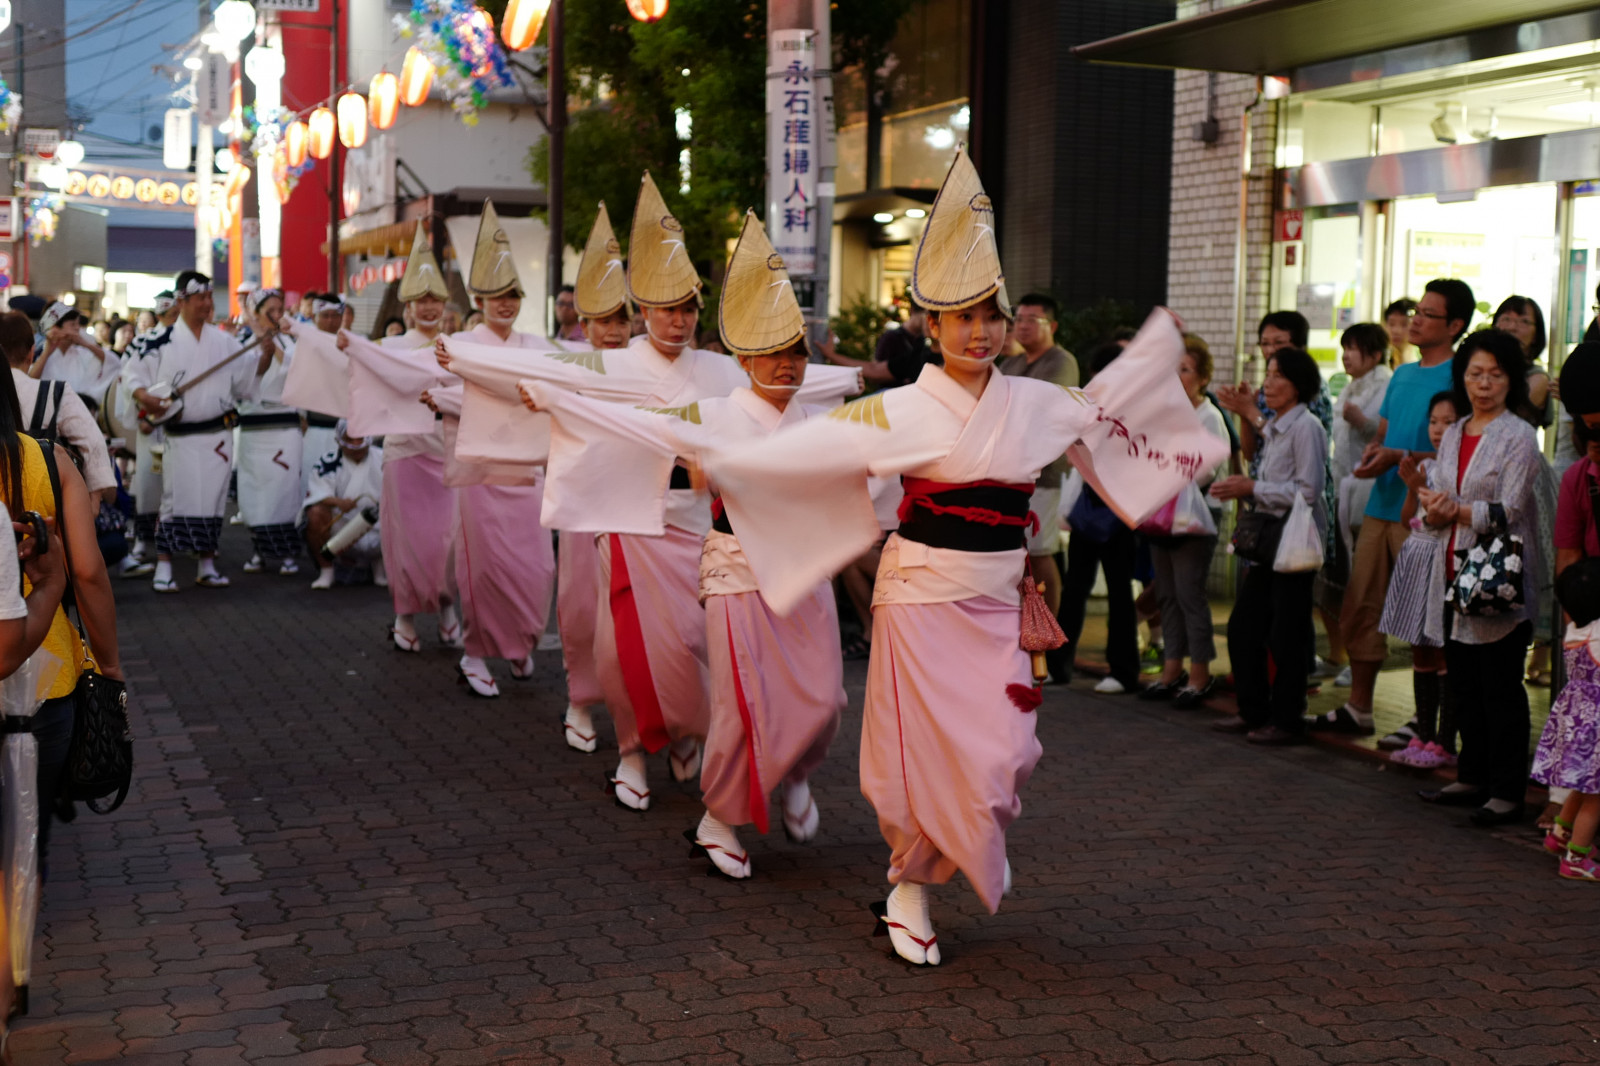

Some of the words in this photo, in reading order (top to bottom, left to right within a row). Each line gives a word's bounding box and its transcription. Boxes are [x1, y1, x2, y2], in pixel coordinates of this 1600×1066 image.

[783, 60, 810, 233] 永石産婦人科
